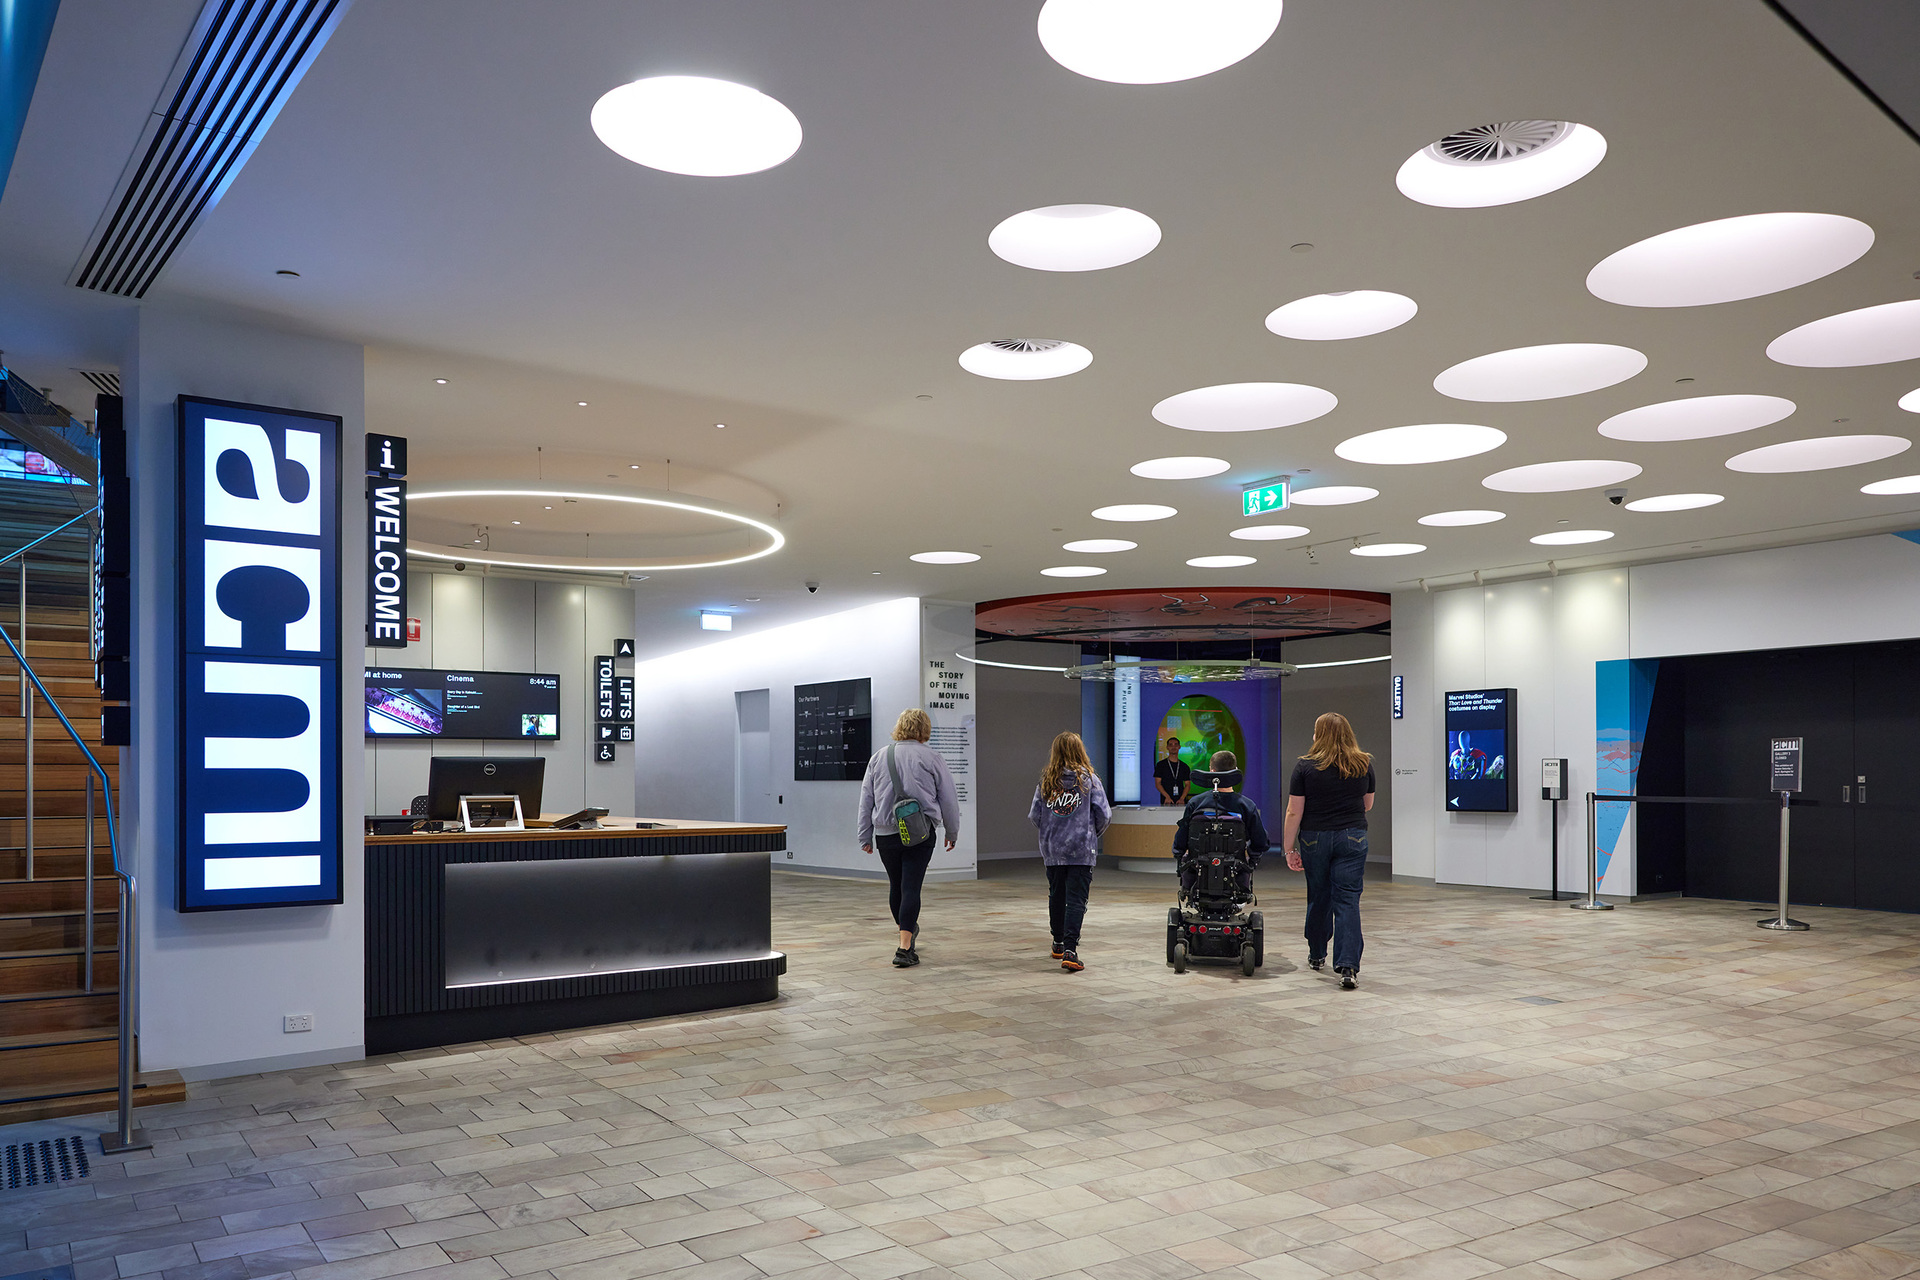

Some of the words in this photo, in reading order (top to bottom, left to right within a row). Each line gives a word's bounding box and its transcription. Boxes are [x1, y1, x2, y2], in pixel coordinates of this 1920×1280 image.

[374, 485, 401, 640] WELCOME
[204, 417, 321, 892] acmi
[382, 671, 402, 679] home
[446, 674, 475, 682] Cinema
[938, 671, 964, 679] STORY
[600, 658, 613, 718] TOILETS
[620, 679, 632, 719] LIFTS
[938, 692, 970, 700] MOVING
[929, 701, 955, 709] IMAGE
